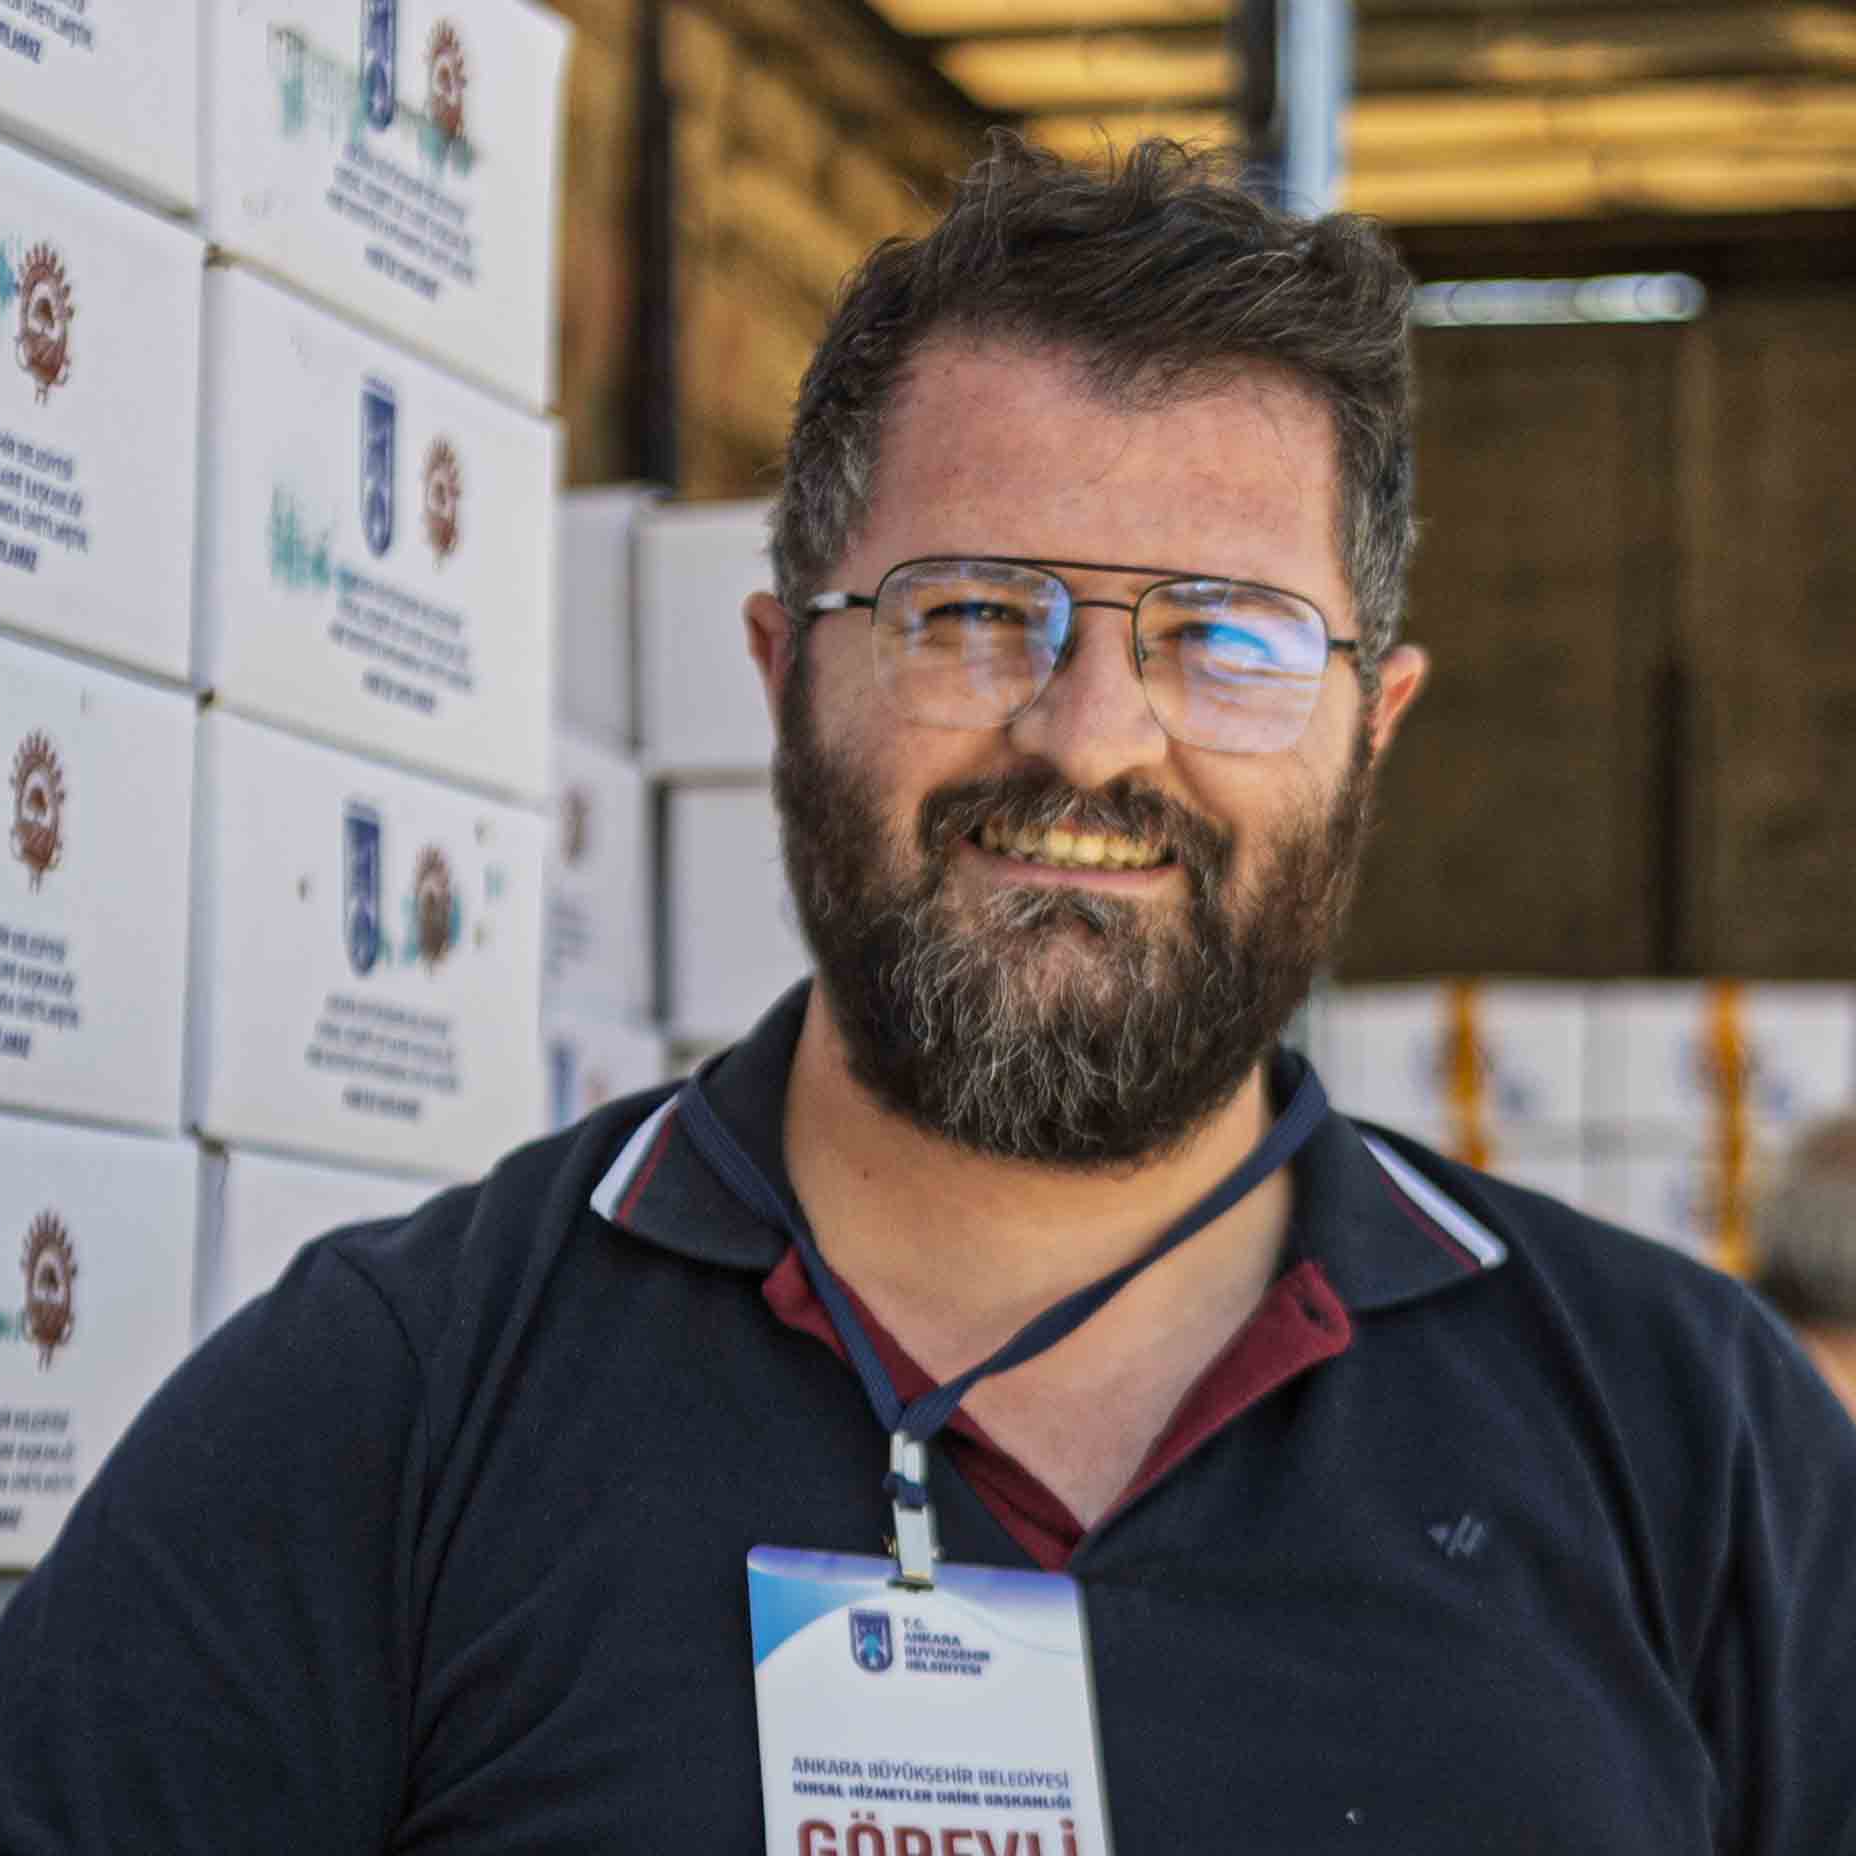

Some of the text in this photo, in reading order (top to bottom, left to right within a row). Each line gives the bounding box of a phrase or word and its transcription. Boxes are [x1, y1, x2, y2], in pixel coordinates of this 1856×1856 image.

[791, 1756, 1070, 1789] ANKARA BÜYÜKŞEHİR BELEDİYESİ
